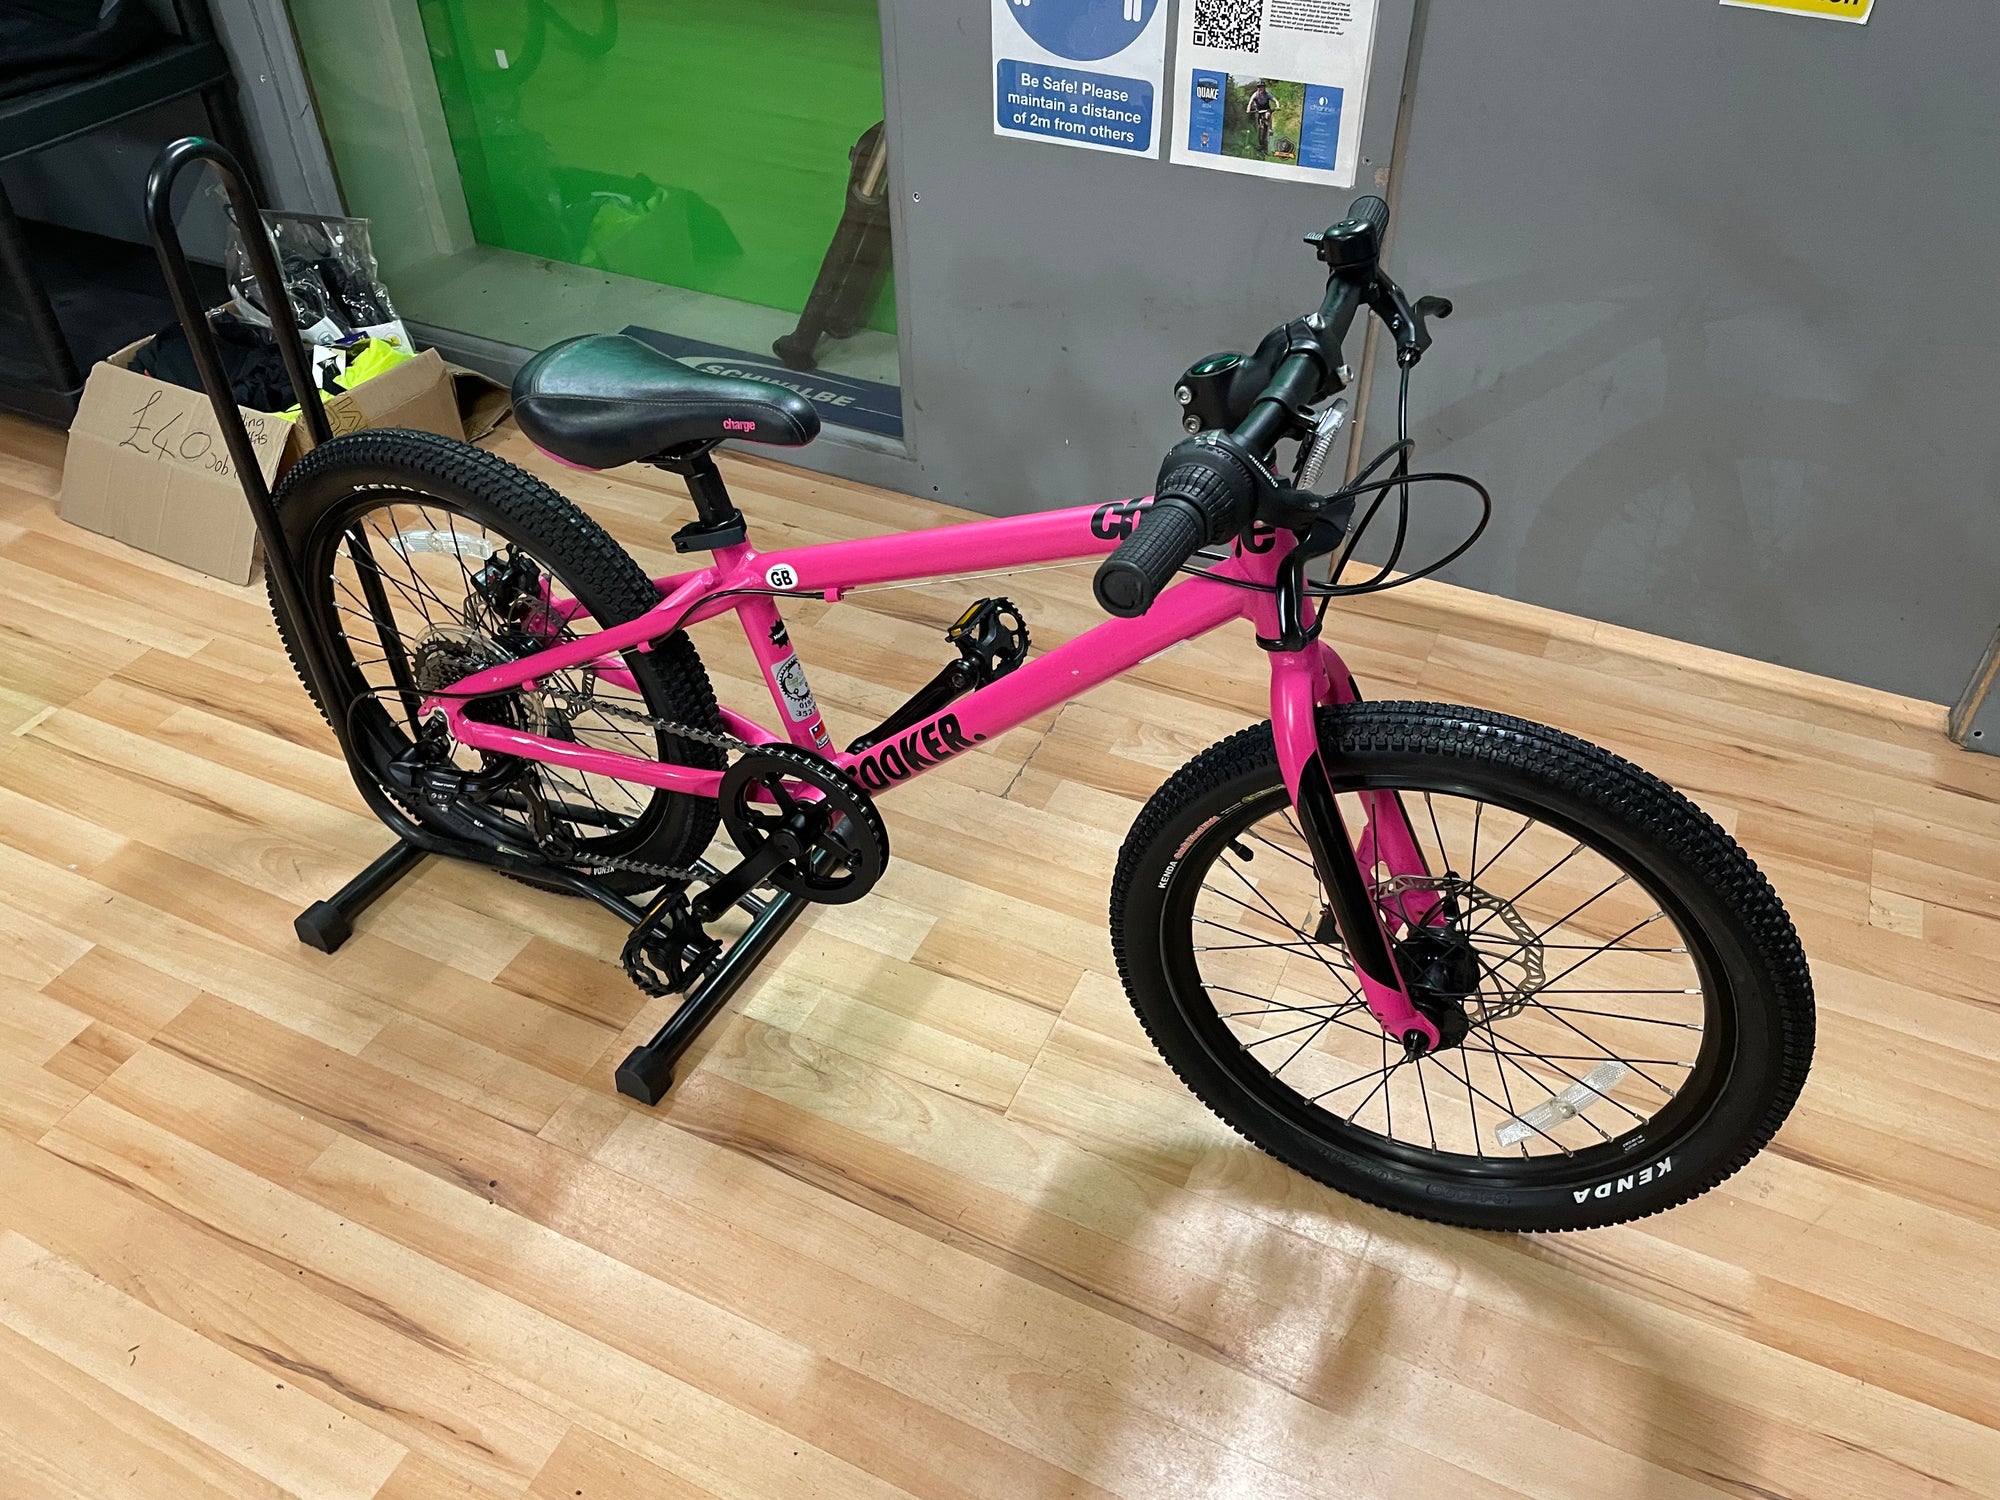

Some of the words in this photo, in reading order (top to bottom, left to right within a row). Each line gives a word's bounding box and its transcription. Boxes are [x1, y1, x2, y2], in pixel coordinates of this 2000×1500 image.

[1021, 72, 1039, 87] Be
[1042, 76, 1078, 94] Safe!
[1082, 82, 1129, 102] Please
[1196, 86, 1219, 100] QUAKE
[1007, 93, 1066, 112] maintain
[1069, 104, 1078, 114] a
[1081, 103, 1142, 124] distance
[1013, 112, 1027, 124] of
[1030, 113, 1050, 129] 2m
[1054, 117, 1086, 135] from
[1089, 126, 1135, 143] others
[119, 390, 212, 460] £40
[722, 418, 757, 433] charge
[770, 570, 793, 587] GB
[1158, 860, 1179, 889] KENDA
[1573, 1156, 1673, 1204] KENDA
